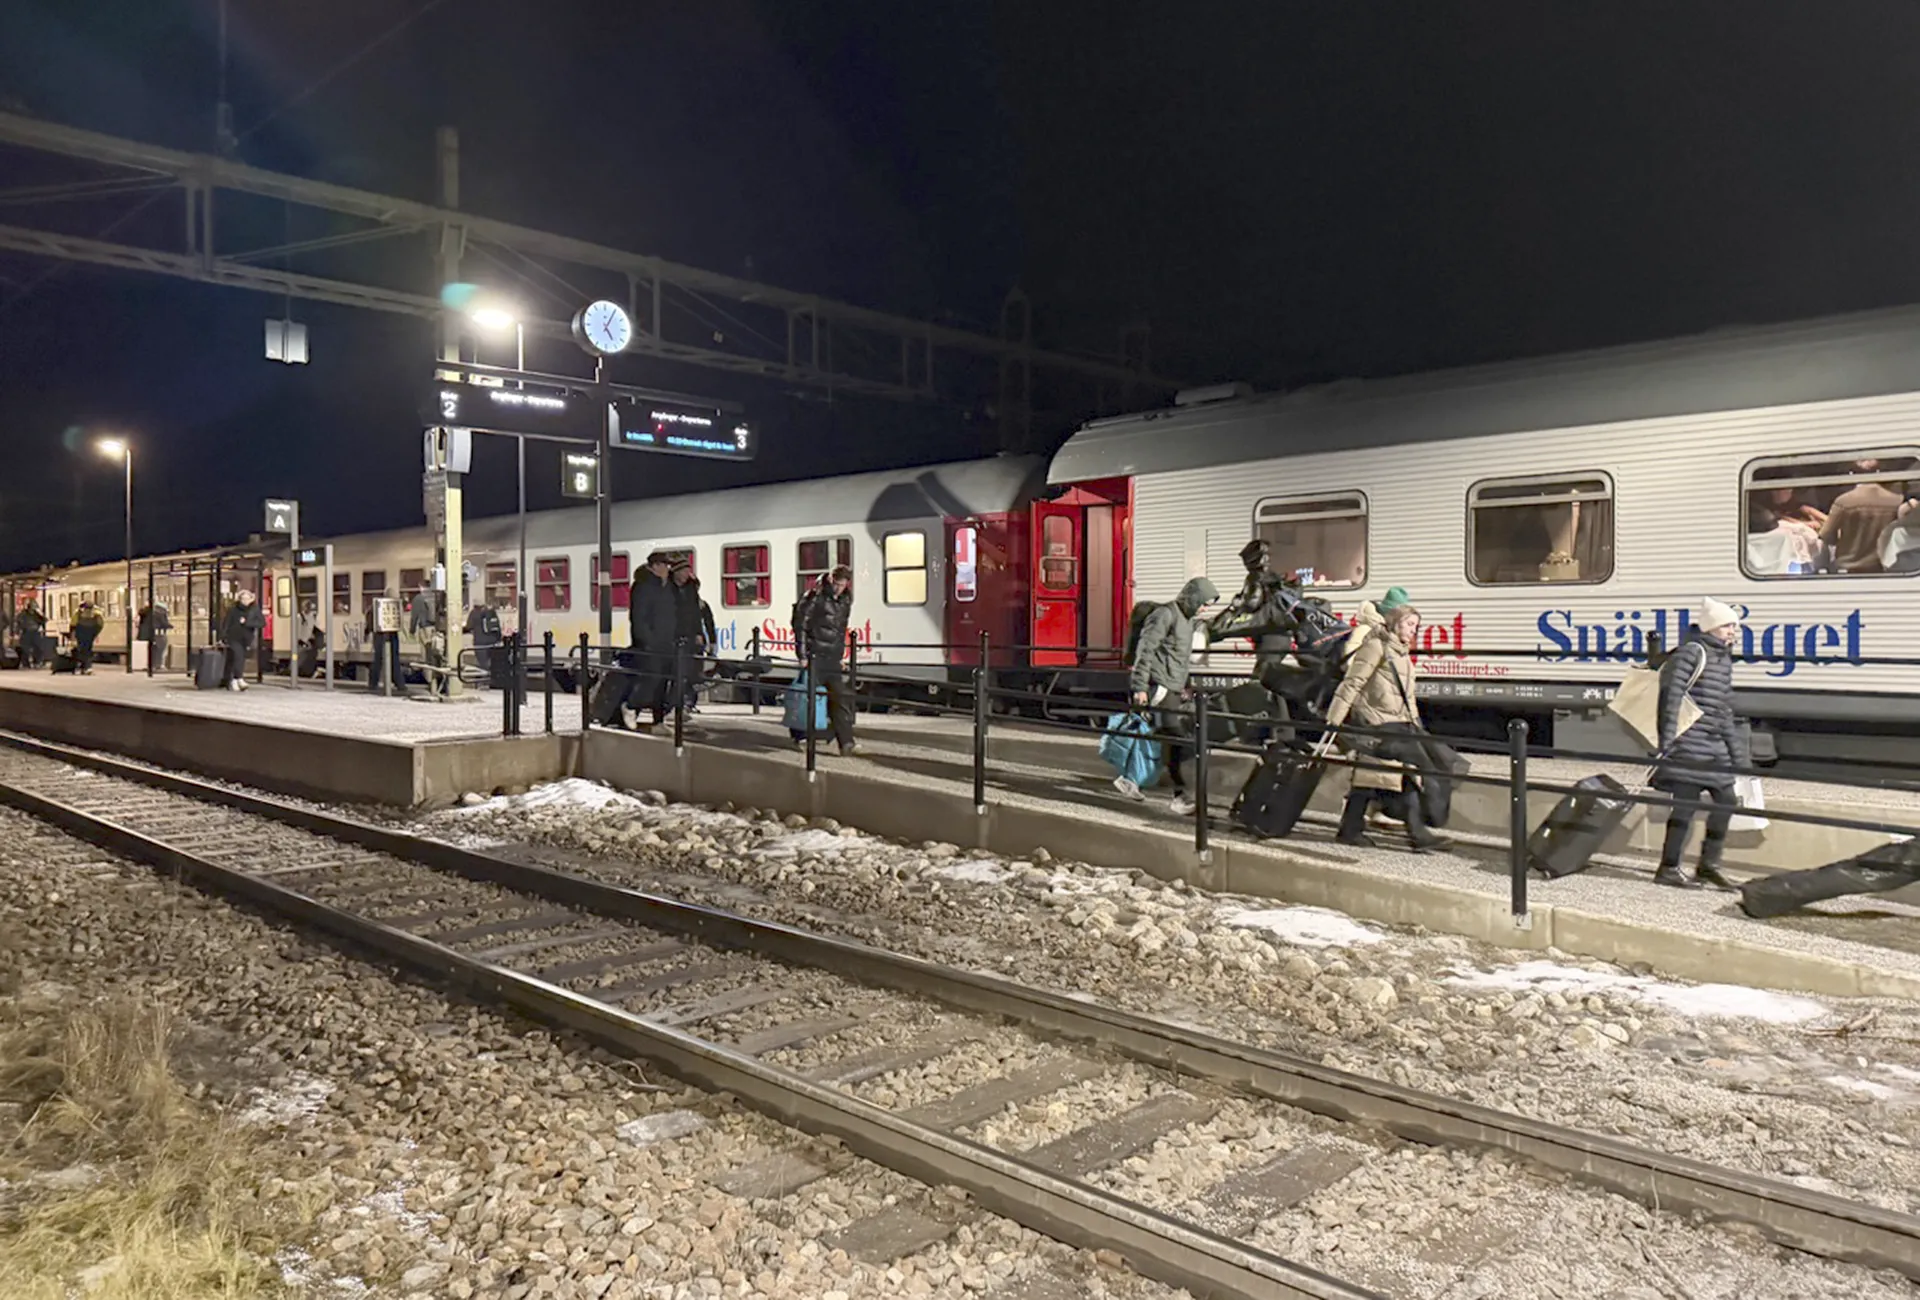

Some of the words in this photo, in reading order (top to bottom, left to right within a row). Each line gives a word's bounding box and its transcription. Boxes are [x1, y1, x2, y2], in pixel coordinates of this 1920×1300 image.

[443, 401, 456, 418] 2
[737, 435, 747, 449] 3
[575, 472, 588, 492] B
[273, 514, 286, 529] A
[1537, 604, 1865, 677] Snällget
